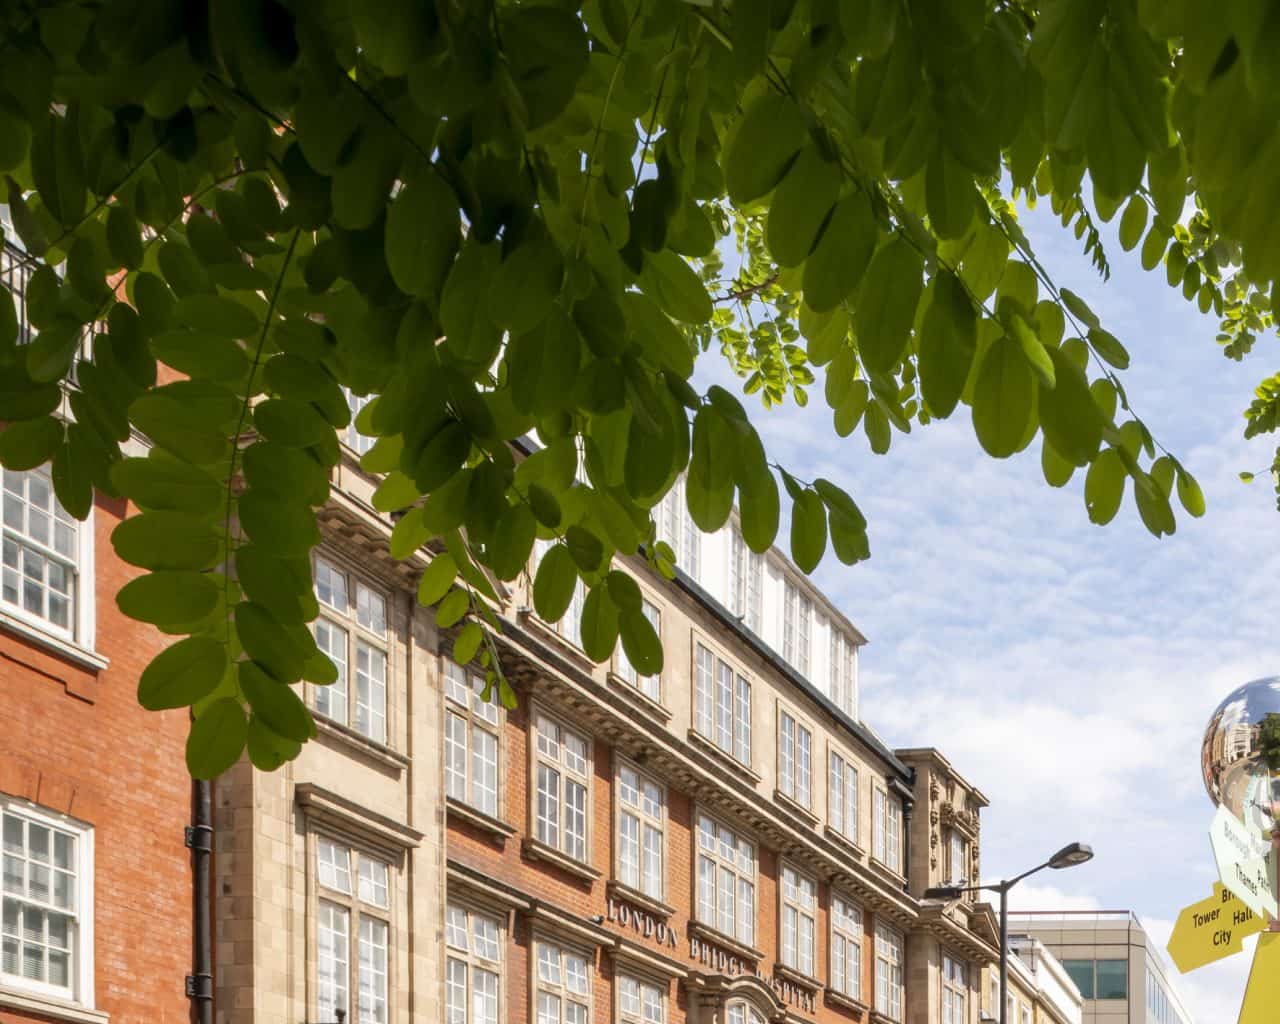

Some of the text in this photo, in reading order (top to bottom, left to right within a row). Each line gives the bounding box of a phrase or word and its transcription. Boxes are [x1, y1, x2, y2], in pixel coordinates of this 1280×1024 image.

[608, 899, 679, 950] LONDON
[689, 938, 746, 976] BRIDGE
[1192, 907, 1221, 928] Tower
[1212, 906, 1253, 946] City Hall
